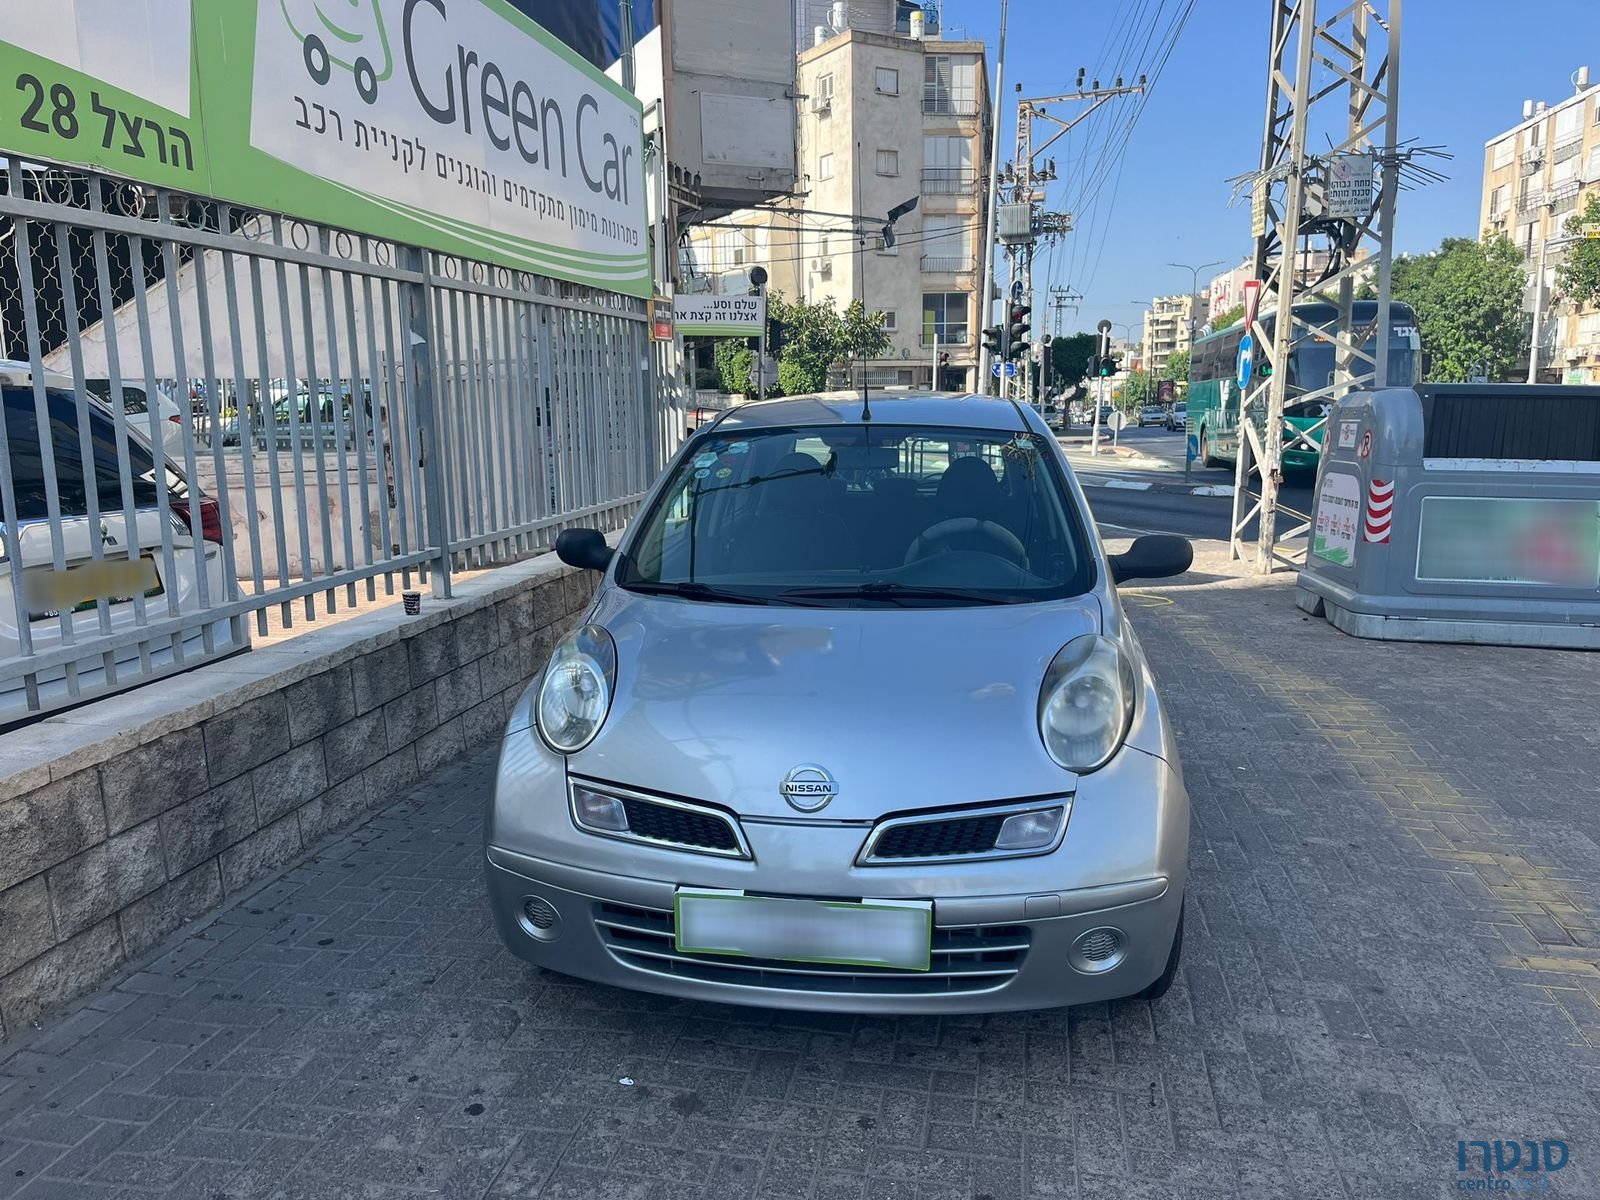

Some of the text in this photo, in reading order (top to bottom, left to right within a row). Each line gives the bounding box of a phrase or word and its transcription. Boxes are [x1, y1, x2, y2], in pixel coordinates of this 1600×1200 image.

[402, 0, 632, 205] Green Car
[16, 73, 194, 171] הרצל 28
[294, 95, 639, 247] פתרונות מימון מתקדמים והוגנים לקניית רכב
[734, 300, 757, 310] שלם
[690, 311, 712, 323] קצת
[715, 312, 726, 320] זה
[729, 310, 757, 321] אצלנו
[785, 784, 831, 792] NISSAN
